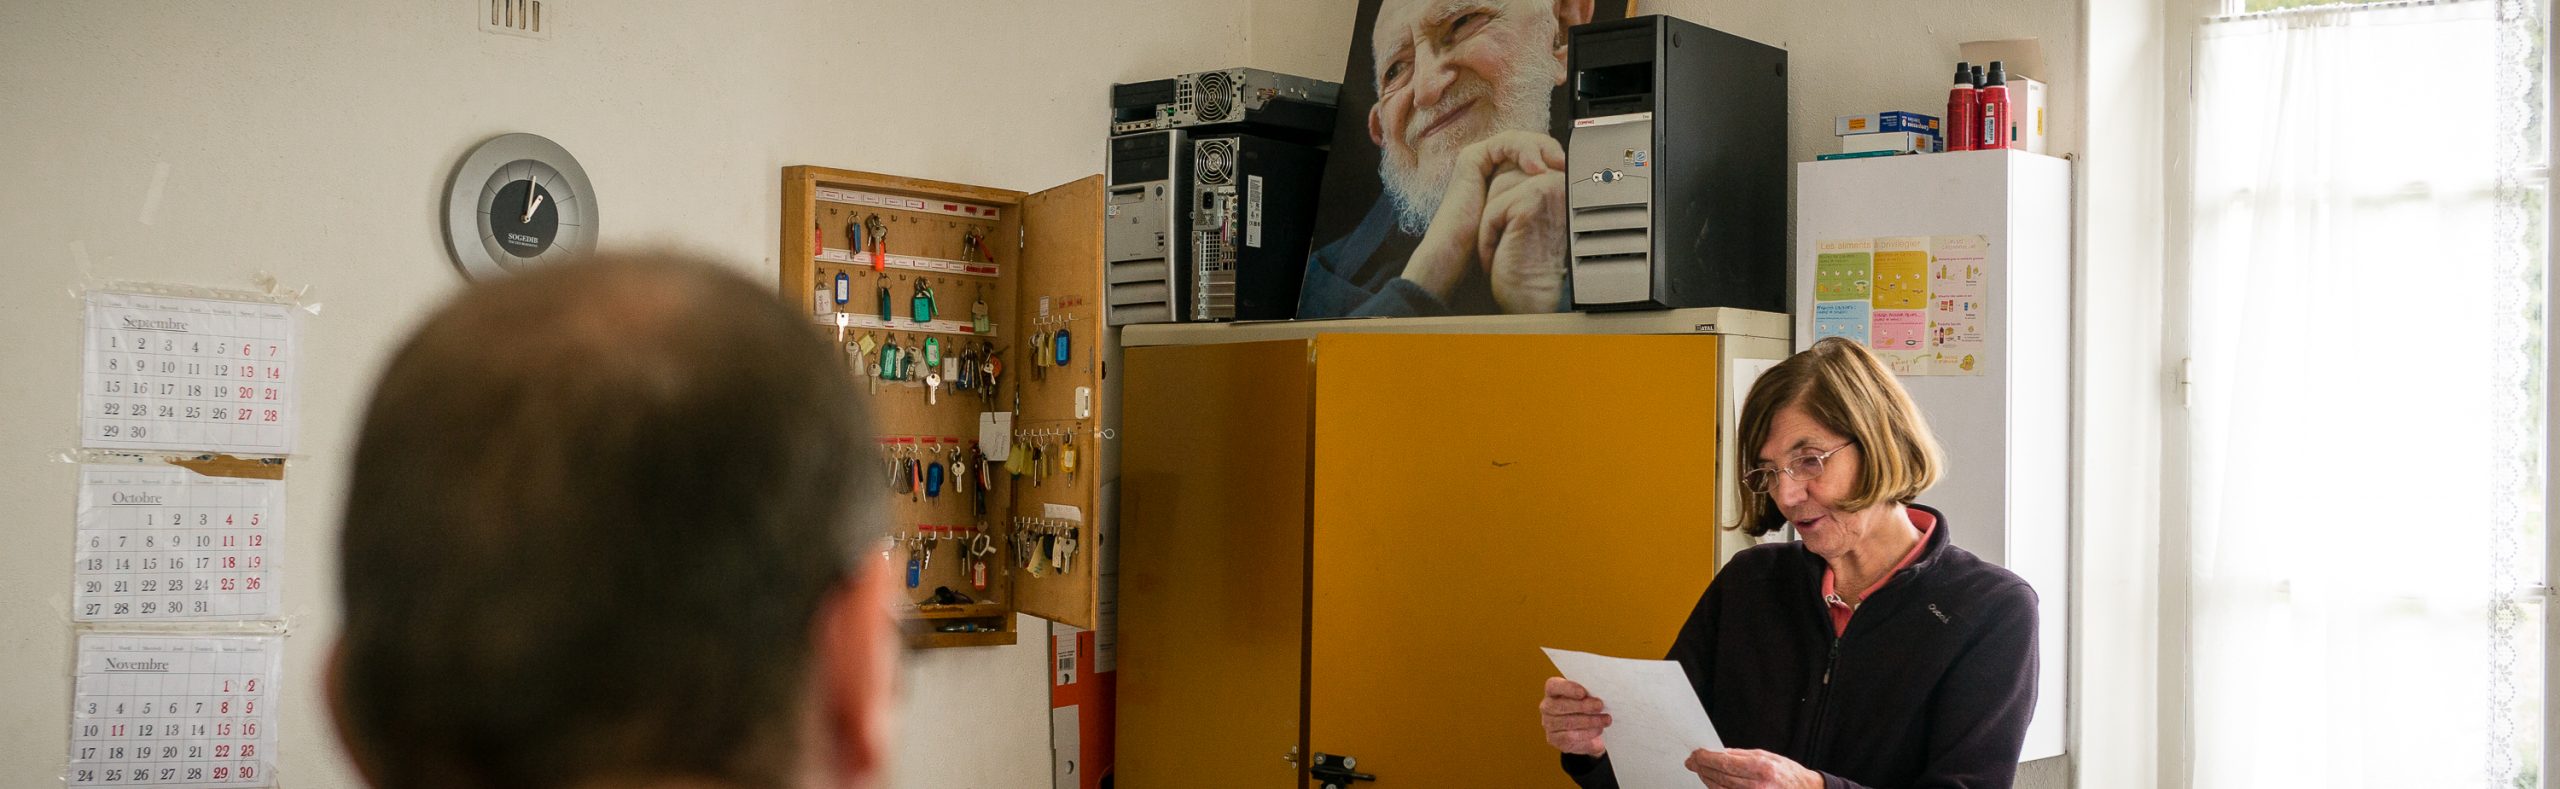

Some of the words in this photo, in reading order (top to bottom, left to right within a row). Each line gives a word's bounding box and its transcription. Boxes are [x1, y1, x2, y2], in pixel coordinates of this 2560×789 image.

[508, 233, 538, 244] SOGEDIB
[1838, 241, 1871, 249] aliments
[122, 315, 188, 331] Septembre
[112, 337, 116, 347] 1
[138, 338, 145, 349] 2
[164, 339, 172, 351] 3
[192, 342, 199, 352] 4
[217, 343, 225, 354] 5
[244, 344, 250, 356] 6
[270, 346, 276, 356] 7
[109, 359, 117, 370] 8
[137, 360, 145, 371] 9
[161, 362, 175, 373] 10
[188, 363, 200, 375] 11
[215, 365, 227, 376] 12
[241, 366, 253, 377] 13
[267, 368, 279, 379] 14
[106, 381, 120, 392] 15
[133, 383, 147, 393] 16
[161, 384, 174, 394] 17
[188, 385, 201, 396] 18
[215, 386, 227, 397] 19
[239, 386, 253, 398] 20
[265, 388, 277, 400] 21
[105, 403, 119, 414] 22
[132, 404, 146, 416] 23
[159, 406, 173, 417] 24
[186, 407, 200, 418] 25
[212, 408, 227, 419] 26
[238, 409, 252, 420] 27
[264, 410, 277, 421] 28
[104, 426, 119, 437] 29
[131, 426, 146, 438] 30
[112, 488, 162, 503] Octobre
[148, 514, 152, 525] 1
[174, 514, 181, 525] 2
[200, 514, 207, 525] 3
[226, 515, 232, 525] 4
[251, 514, 258, 525] 5
[91, 536, 99, 548] 6
[120, 536, 126, 547] 7
[146, 536, 153, 547] 8
[173, 536, 180, 547] 9
[197, 536, 210, 547] 10
[223, 536, 234, 546] 11
[249, 535, 262, 546] 12
[88, 559, 102, 570] 13
[116, 559, 130, 569] 14
[143, 559, 156, 569] 15
[170, 558, 183, 569] 16
[197, 557, 209, 568] 17
[223, 557, 235, 568] 18
[249, 556, 260, 568] 19
[86, 581, 101, 592] 20
[114, 581, 127, 592] 21
[142, 580, 156, 591] 22
[169, 580, 183, 591] 23
[195, 579, 208, 590] 24
[221, 578, 234, 590] 25
[247, 578, 260, 589] 26
[86, 604, 100, 614] 27
[114, 603, 129, 614] 28
[141, 602, 156, 613] 29
[168, 601, 183, 613] 30
[194, 601, 207, 612] 31
[105, 658, 169, 670] Novembre
[224, 680, 229, 692] 1
[248, 680, 255, 692] 2
[88, 703, 97, 714] 3
[116, 703, 124, 714] 4
[142, 703, 151, 714] 5
[170, 703, 177, 713] 6
[196, 703, 203, 713] 7
[221, 702, 228, 713] 8
[246, 702, 253, 713] 9
[83, 725, 98, 736] 10
[112, 725, 124, 736] 11
[139, 725, 153, 736] 12
[166, 724, 179, 736] 13
[192, 725, 205, 735] 14
[217, 724, 230, 735] 15
[243, 724, 255, 735] 16
[81, 748, 95, 759] 17
[110, 747, 123, 759] 18
[137, 747, 151, 758] 19
[163, 746, 177, 758] 20
[189, 746, 201, 757] 21
[215, 745, 229, 757] 22
[241, 745, 254, 757] 23
[78, 770, 93, 781] 24
[106, 770, 121, 781] 25
[133, 769, 149, 780] 26
[161, 769, 175, 780] 27
[187, 768, 201, 779] 28
[213, 767, 228, 779] 29
[239, 767, 253, 778] 30
